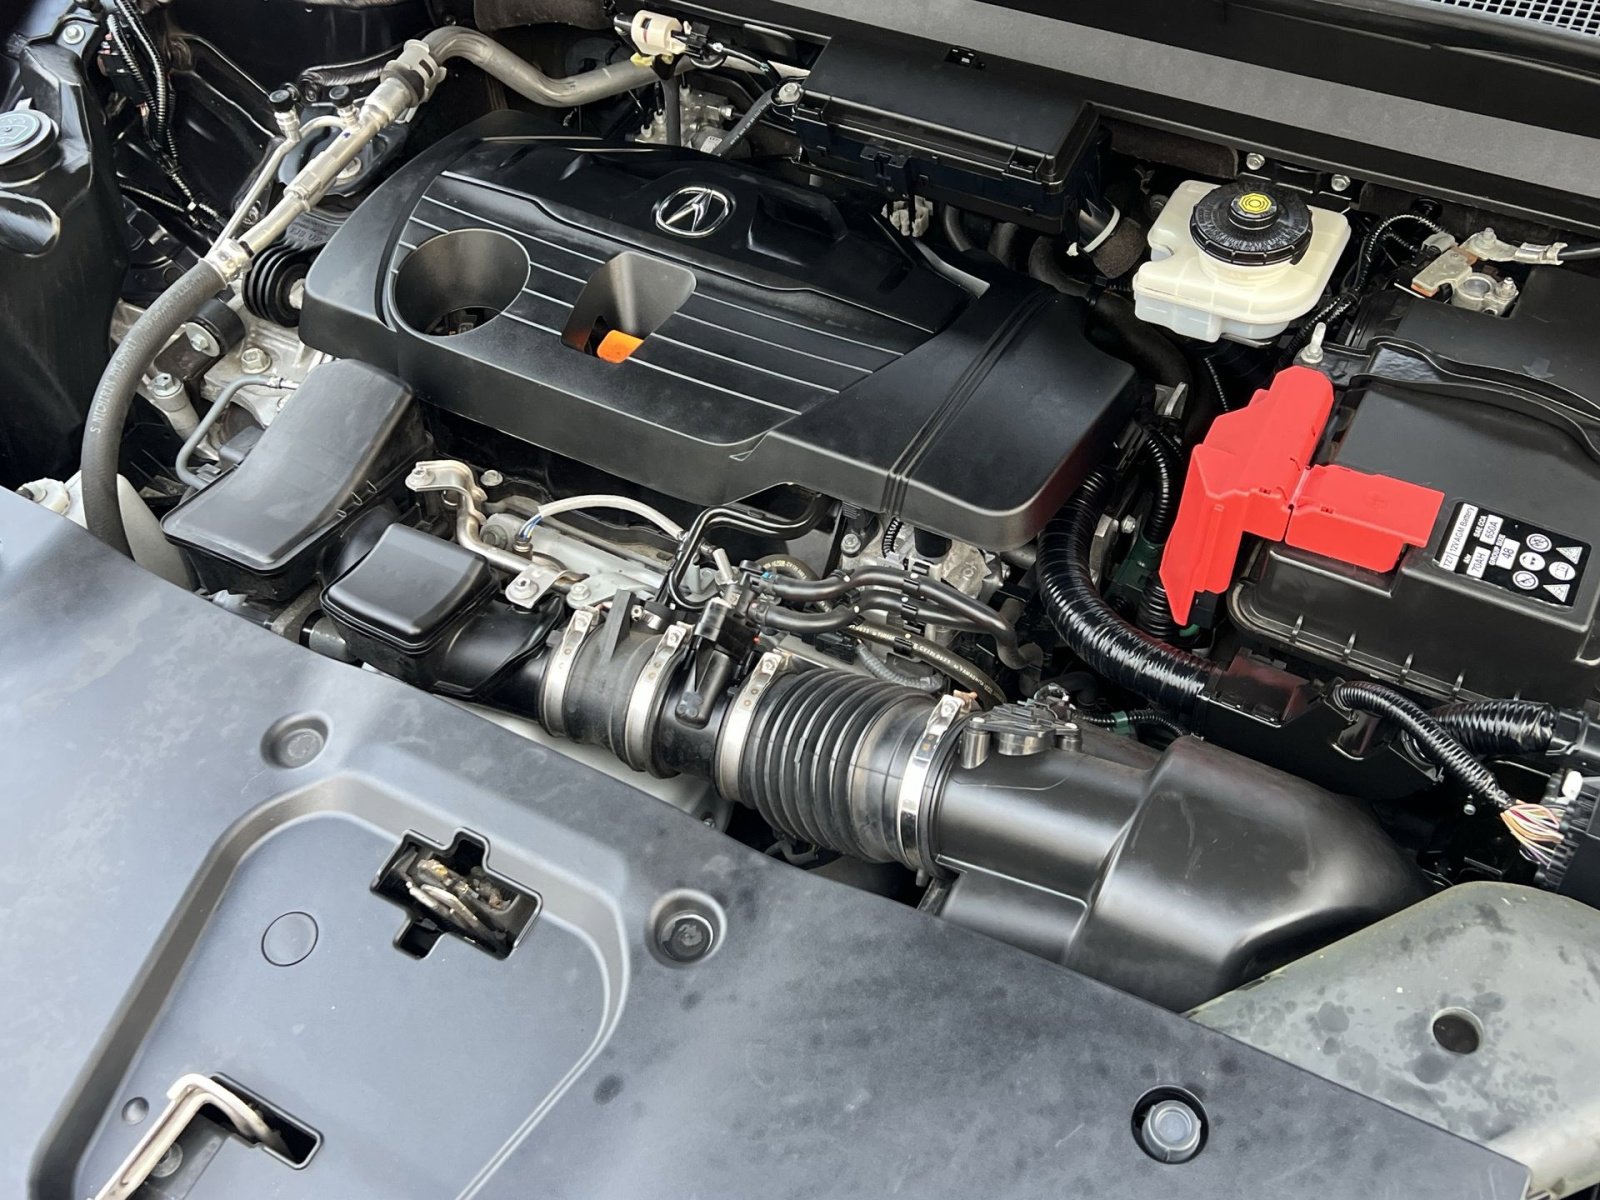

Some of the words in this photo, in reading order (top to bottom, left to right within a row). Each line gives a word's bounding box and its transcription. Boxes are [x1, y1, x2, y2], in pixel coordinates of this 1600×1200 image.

[92, 379, 115, 424] NICHIRIN
[1460, 507, 1475, 527] Battery
[1485, 521, 1498, 539] 650A
[1471, 552, 1486, 572] 70AH
[1502, 547, 1514, 559] 48
